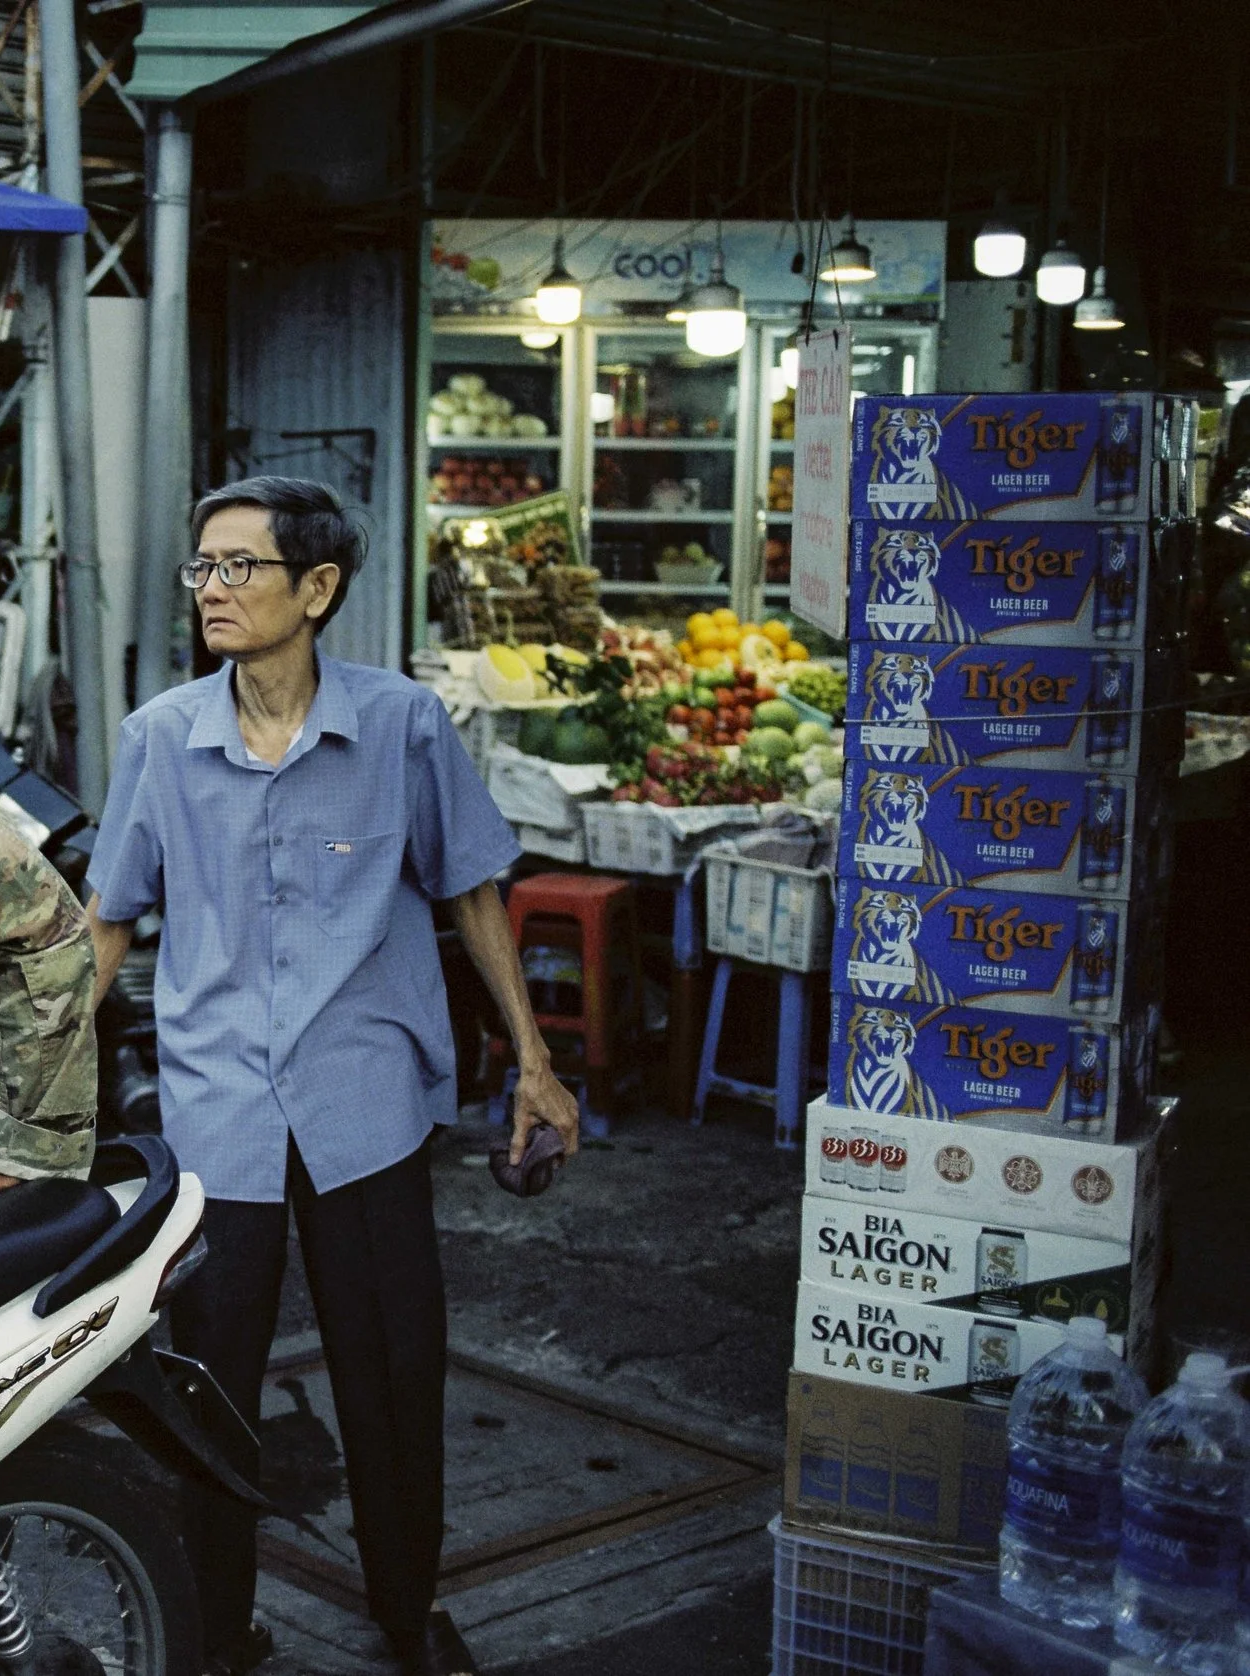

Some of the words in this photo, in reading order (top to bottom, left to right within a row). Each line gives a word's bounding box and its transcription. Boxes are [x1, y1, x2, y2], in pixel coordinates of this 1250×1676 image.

[967, 410, 1086, 469] Tiger
[991, 474, 1022, 486] LAGER
[1025, 474, 1050, 486] BEER
[964, 535, 1085, 593] Tiger
[990, 598, 1020, 610] LAGER
[1023, 599, 1049, 611] BEER
[959, 660, 1078, 717] Tiger
[983, 722, 1013, 735] LAGER
[1016, 724, 1041, 736] BEER
[952, 783, 1071, 841] Tiger
[976, 844, 1007, 856] LAGER
[1009, 847, 1034, 860] BEER
[945, 904, 1064, 962] Tiger
[969, 964, 999, 977] LAGER
[1002, 968, 1027, 981] BEER
[939, 1023, 1056, 1080] Tiger
[963, 1080, 994, 1095] LAGER
[996, 1085, 1021, 1099] BEER
[853, 1138, 875, 1157] 333
[865, 1214, 905, 1237] BIA
[818, 1227, 953, 1274] SAIGON
[830, 1260, 938, 1293] LAGER
[857, 1303, 897, 1326] BIA
[811, 1314, 945, 1363] SAIGON
[823, 1348, 930, 1383] LAGER
[1007, 1475, 1070, 1516] AQUAFINA
